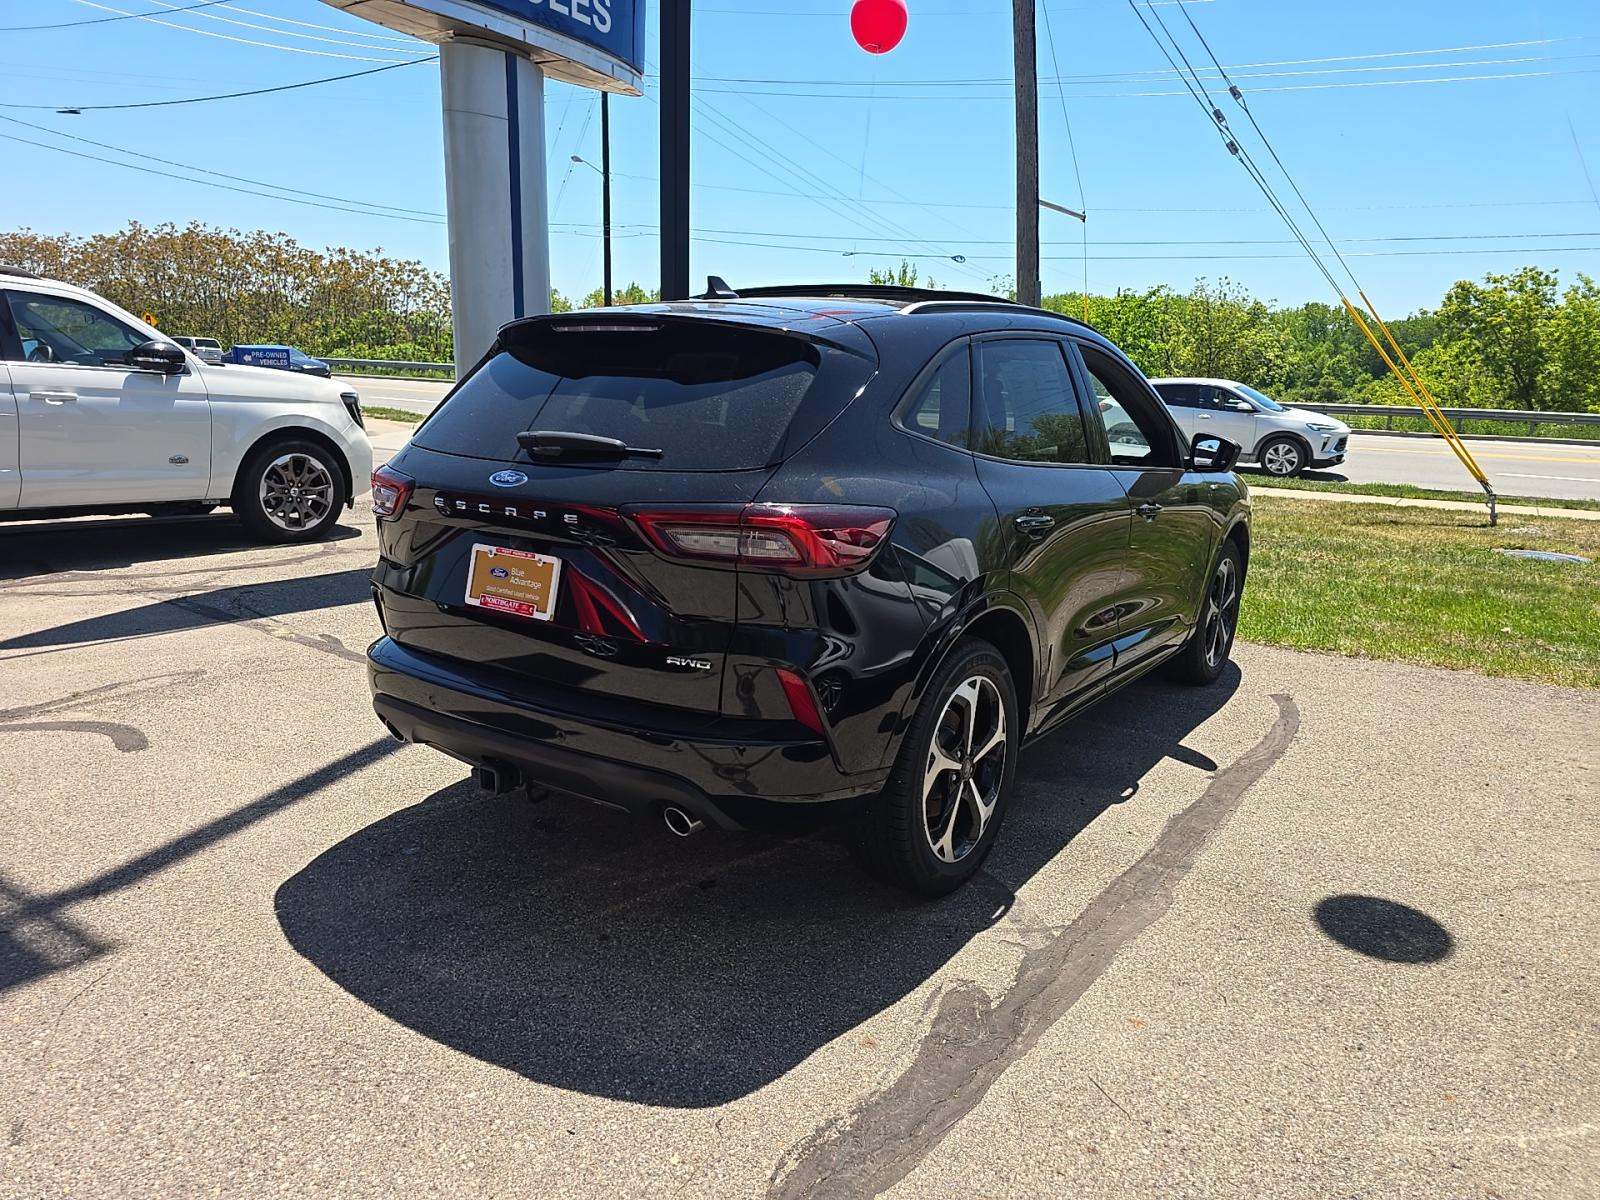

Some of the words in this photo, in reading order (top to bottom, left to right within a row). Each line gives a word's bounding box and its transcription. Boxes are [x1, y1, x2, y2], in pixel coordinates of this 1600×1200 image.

[251, 351, 287, 359] PRE-OWNED
[434, 496, 578, 524] ESCAPE
[510, 567, 525, 577] Blue
[510, 576, 542, 590] Advantage
